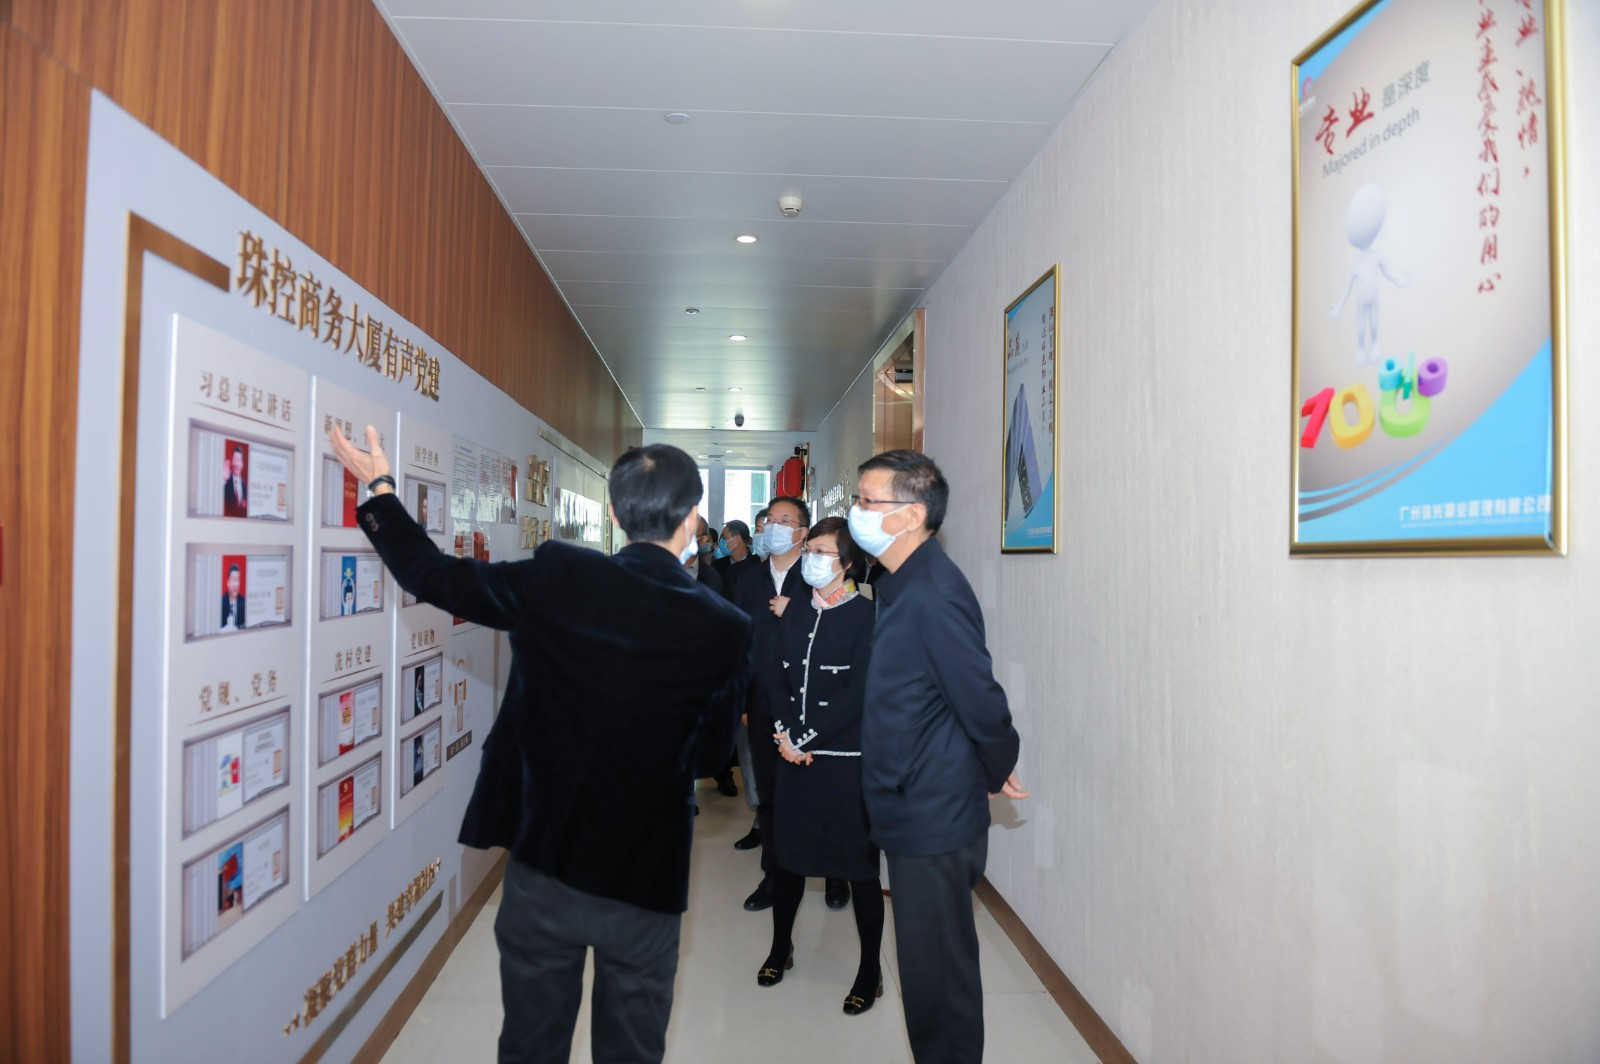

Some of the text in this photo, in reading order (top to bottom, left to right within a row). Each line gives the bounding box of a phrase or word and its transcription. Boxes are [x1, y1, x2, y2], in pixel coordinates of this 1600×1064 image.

[1315, 60, 1431, 155] 专业 是深度
[1322, 107, 1420, 178] Majored in depth
[236, 230, 441, 402] 珠控商务大厦有声党建
[199, 371, 293, 423] 习总书记讲话
[1300, 352, 1449, 449] 100%
[199, 670, 279, 713] 党规、党务
